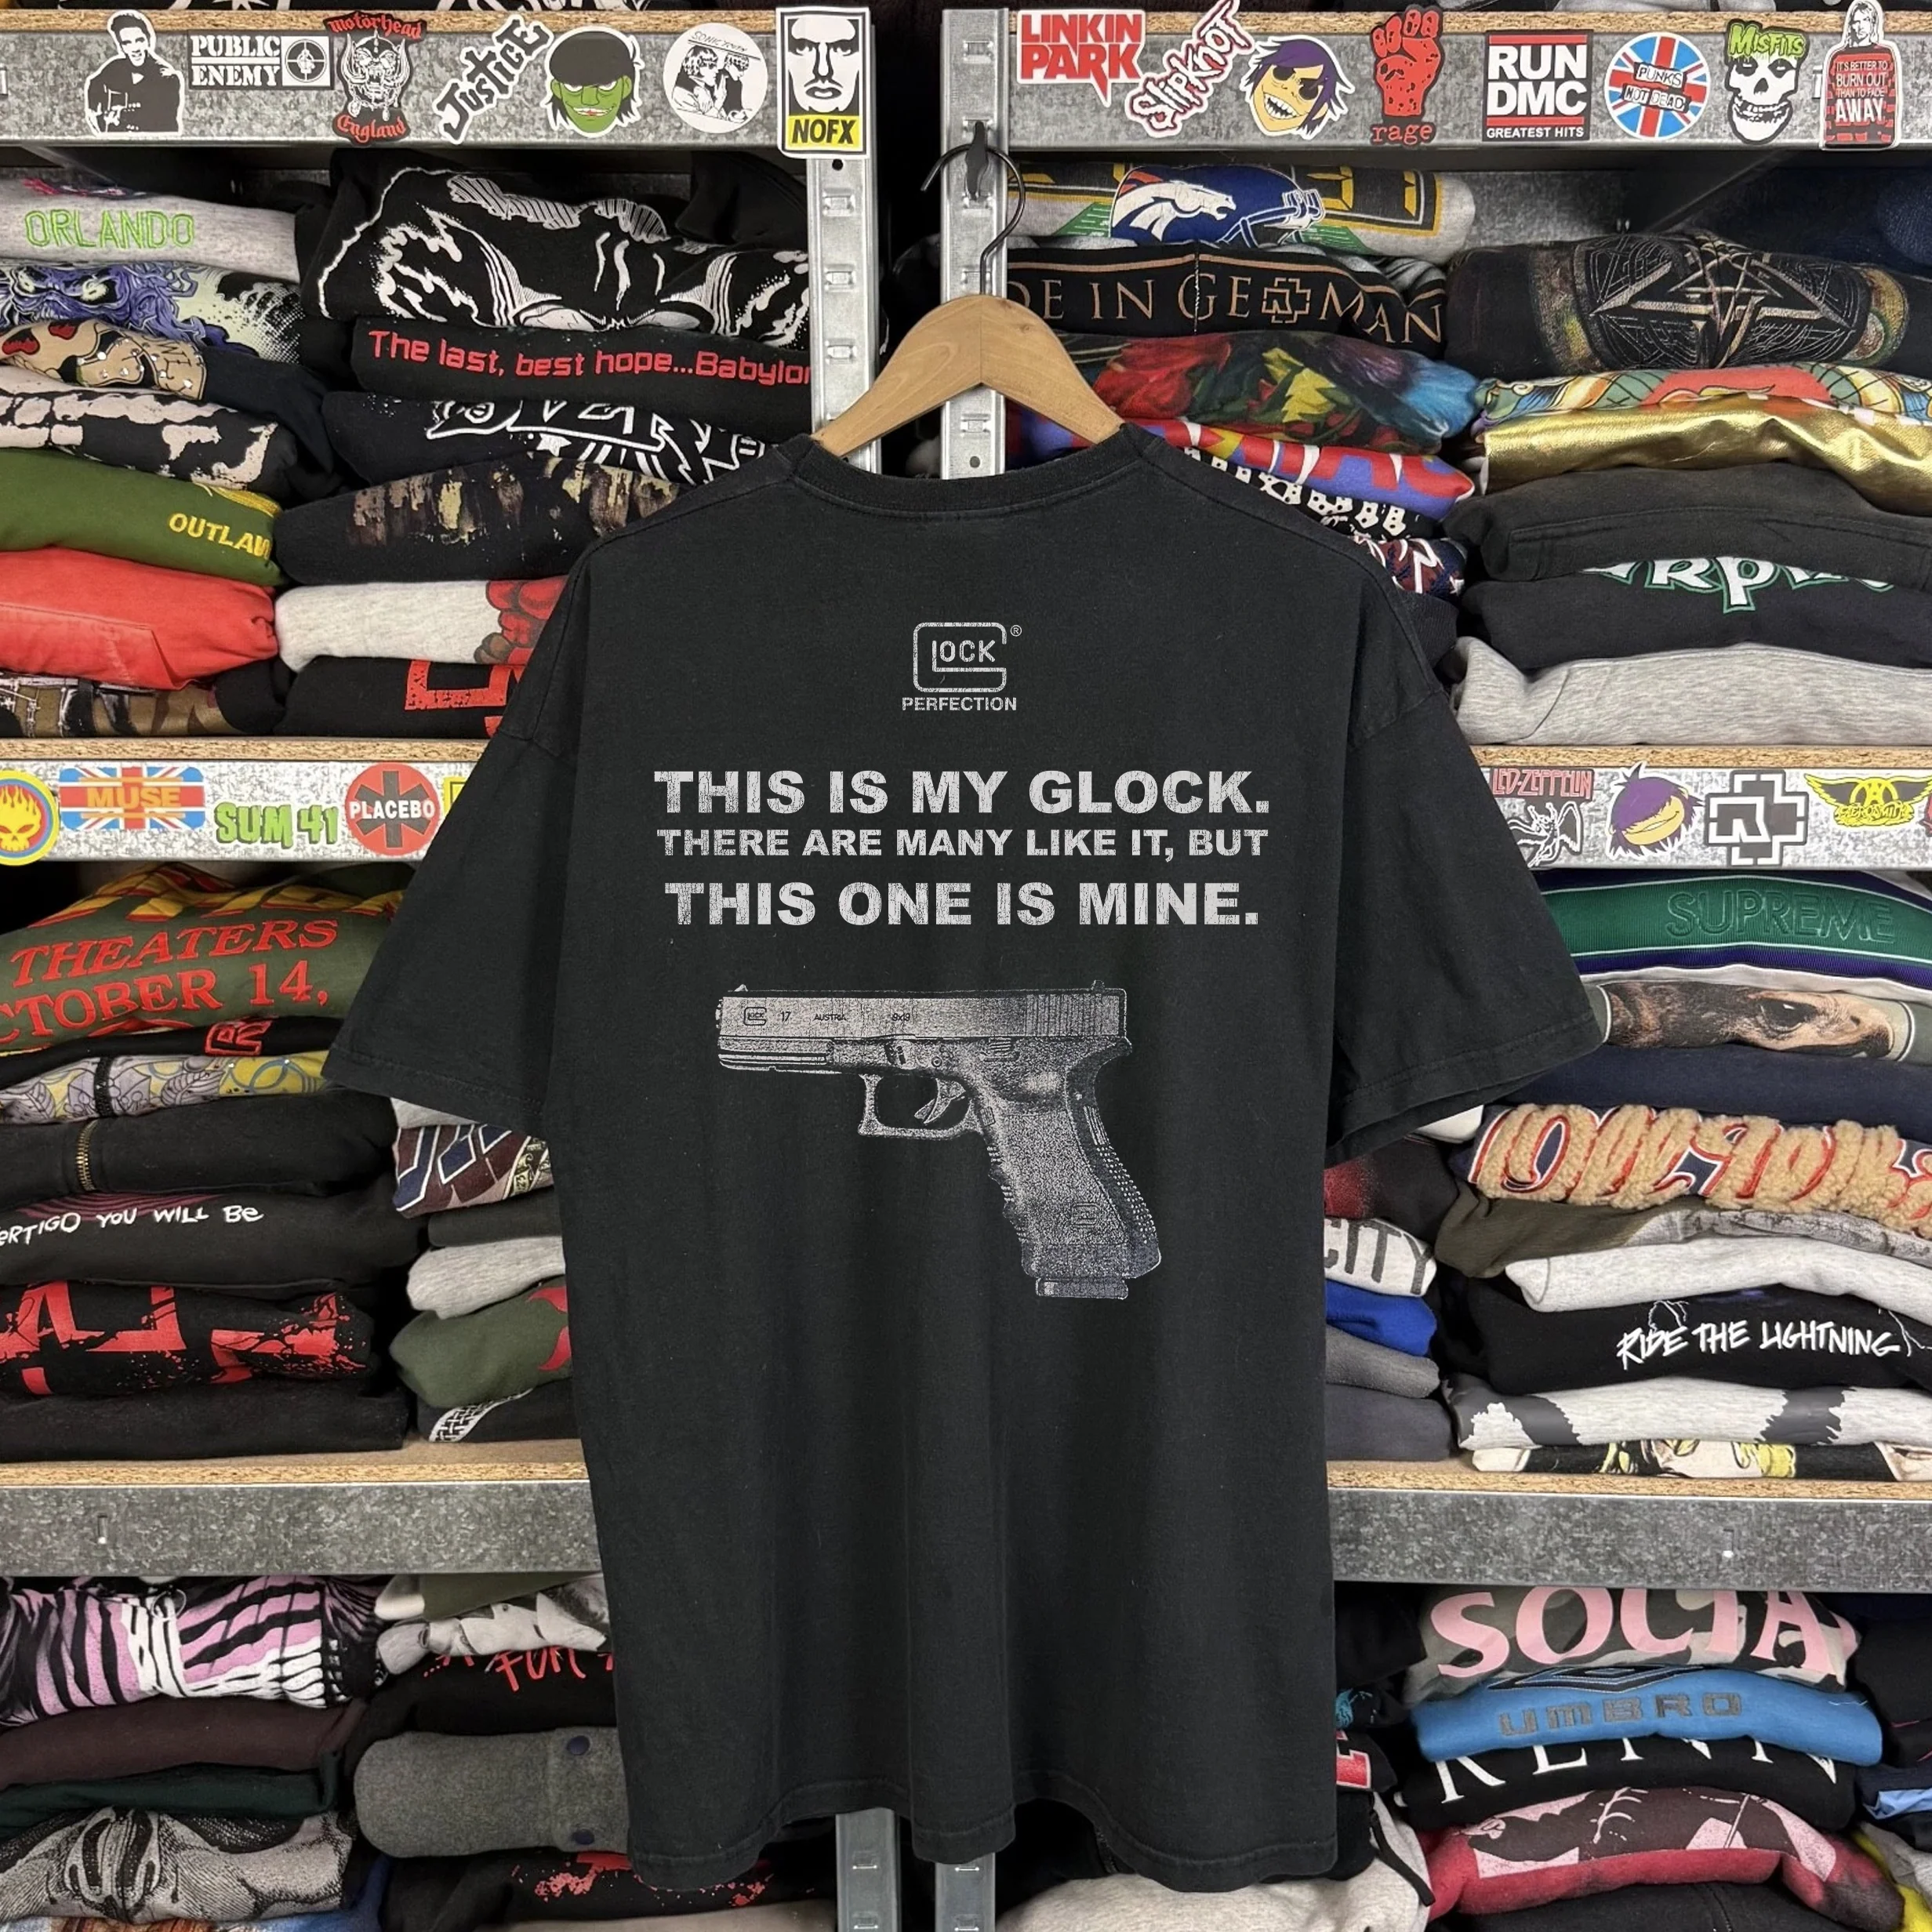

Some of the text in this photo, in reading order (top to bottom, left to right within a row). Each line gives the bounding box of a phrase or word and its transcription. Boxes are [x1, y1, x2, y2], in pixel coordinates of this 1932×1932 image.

[190, 35, 281, 56] PUBLIC
[1022, 14, 1142, 56] LINKIN
[191, 65, 281, 85] ENEMY
[1021, 44, 1142, 100] PARK
[1488, 45, 1587, 80] RUN
[1836, 73, 1864, 87] BURN
[1866, 72, 1887, 86] OUT
[1851, 62, 1877, 71] BETTER
[1879, 61, 1888, 71] TO
[1487, 81, 1587, 116] DMC
[1836, 88, 1885, 97] THAN TO FADE
[1836, 98, 1884, 122] AWAY
[336, 114, 406, 143] England
[791, 119, 855, 145] NOFX
[1372, 125, 1433, 145] rage
[1486, 127, 1584, 138] GREATEST HITS
[24, 209, 194, 249] ORLANDO
[1091, 282, 1153, 320] IN
[369, 331, 430, 362] The
[439, 340, 503, 376] last,
[515, 353, 585, 376] best
[902, 696, 1017, 711] PERFECTION
[87, 786, 181, 808] MUSE
[350, 798, 435, 821] PLACEBO
[655, 771, 1269, 814] THIS IS MY GLOCK.
[215, 802, 339, 849] SUM 41
[657, 830, 1269, 863] THERE ARE MANY LIKE IT, BUT
[664, 882, 1258, 925] THIS ONE IS MINE.
[1665, 889, 1894, 943] SUPREME
[10, 920, 339, 988] THEATERS
[247, 959, 328, 1007] 14,
[781, 1011, 791, 1022] 17
[153, 1205, 209, 1224] WILL
[1616, 1320, 1901, 1371] RIDE THE LIGHTNING
[1430, 1585, 1858, 1678] SOCIA
[1498, 1690, 1742, 1736] UMBRO
